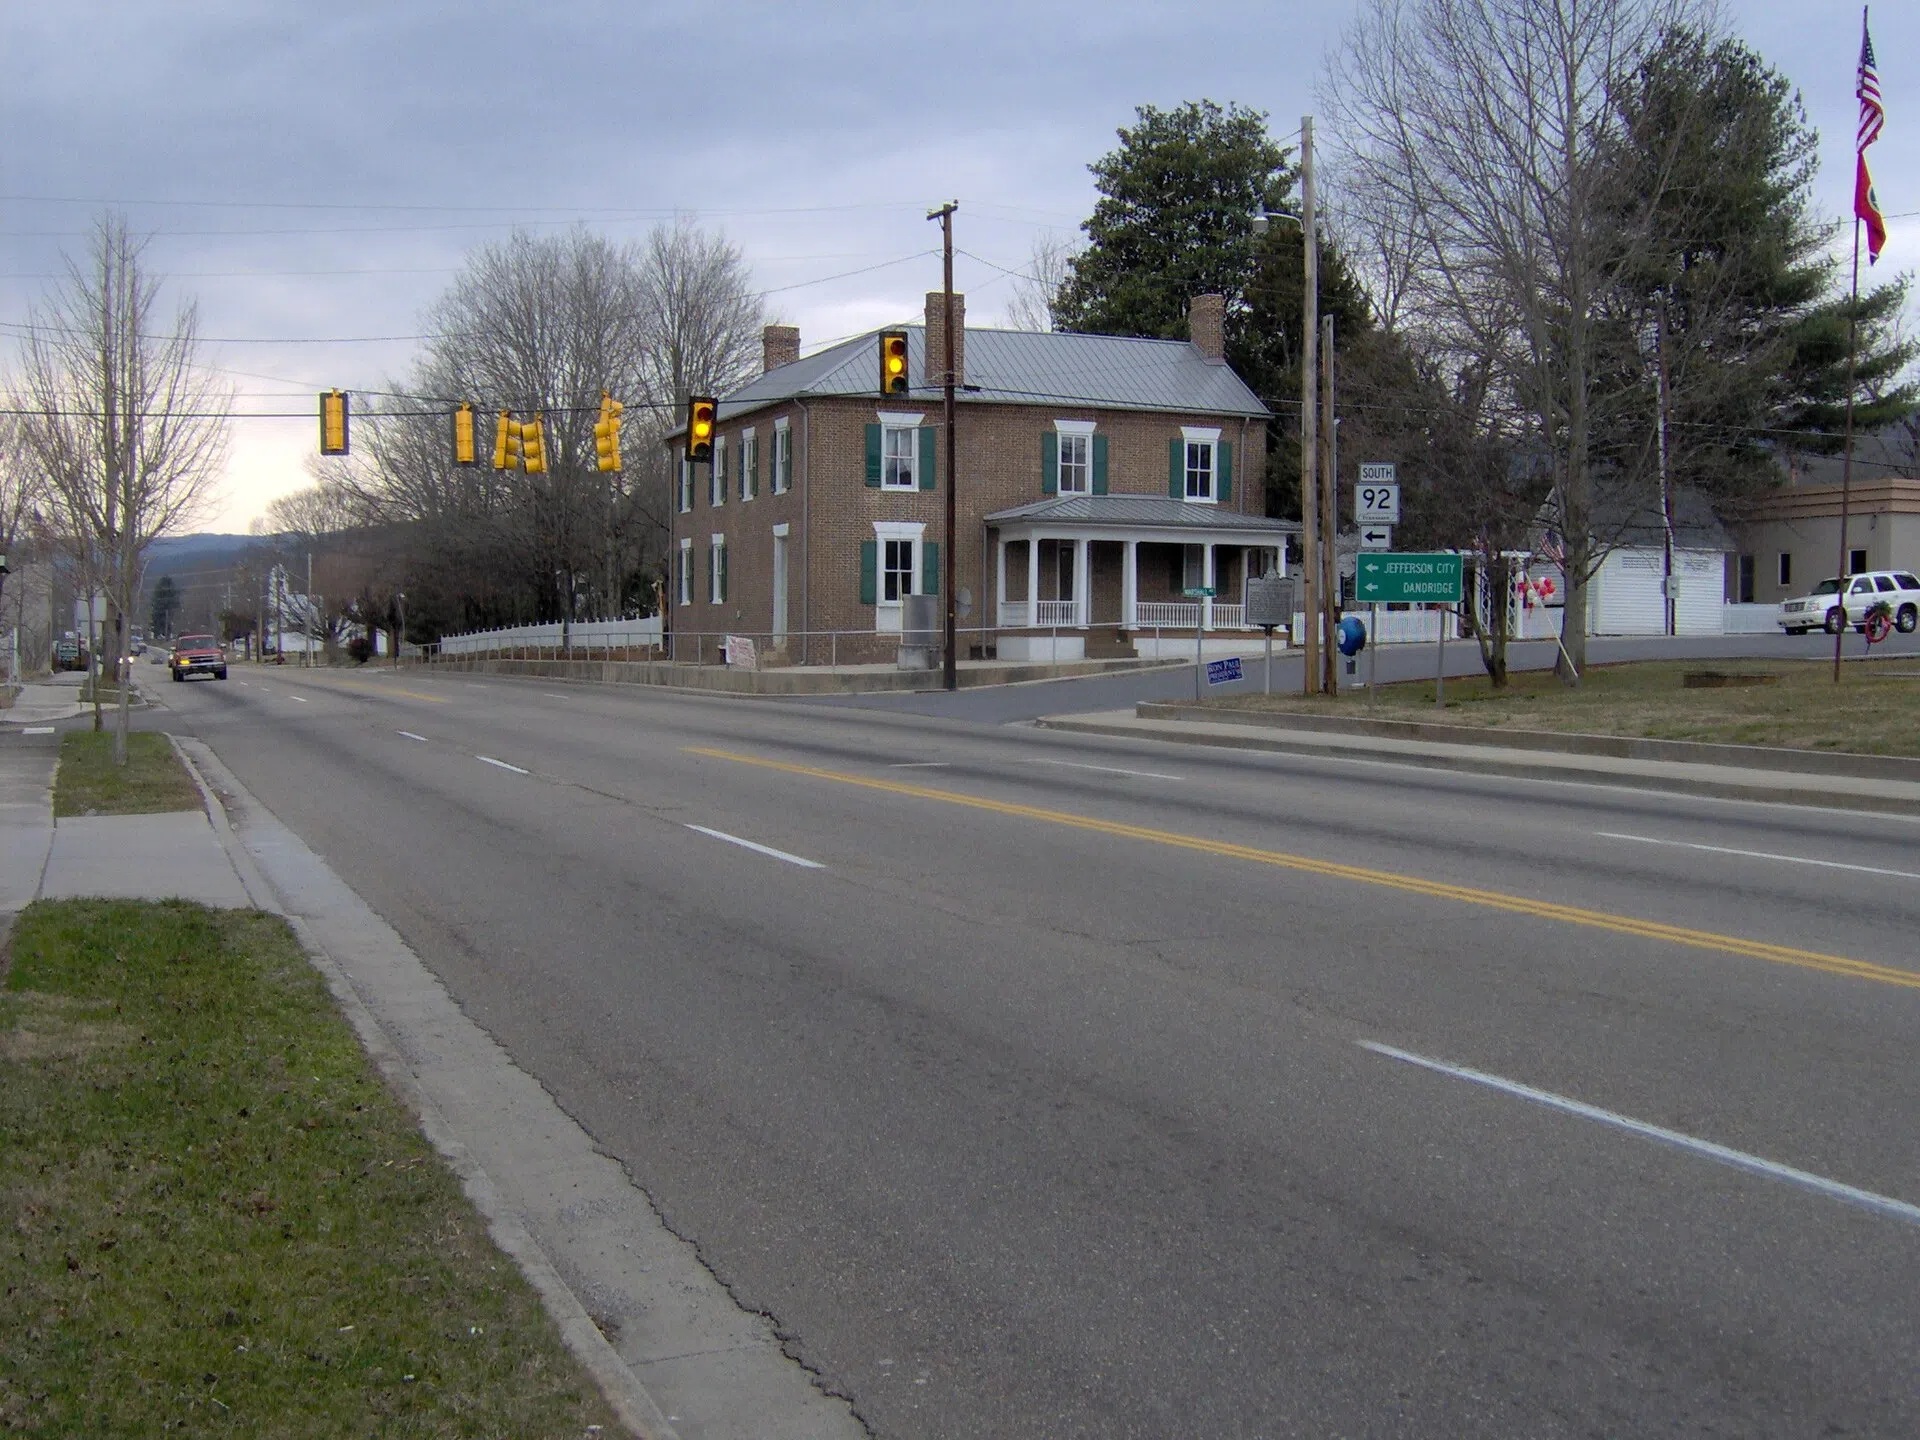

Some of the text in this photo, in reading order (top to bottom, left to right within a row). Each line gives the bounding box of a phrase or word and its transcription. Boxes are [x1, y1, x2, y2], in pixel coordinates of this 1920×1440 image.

[1362, 467, 1393, 479] SOUTH
[1362, 488, 1391, 509] 92
[1384, 562, 1455, 574] JEFFERSON CITY
[1403, 582, 1454, 594] DANDRIDGE
